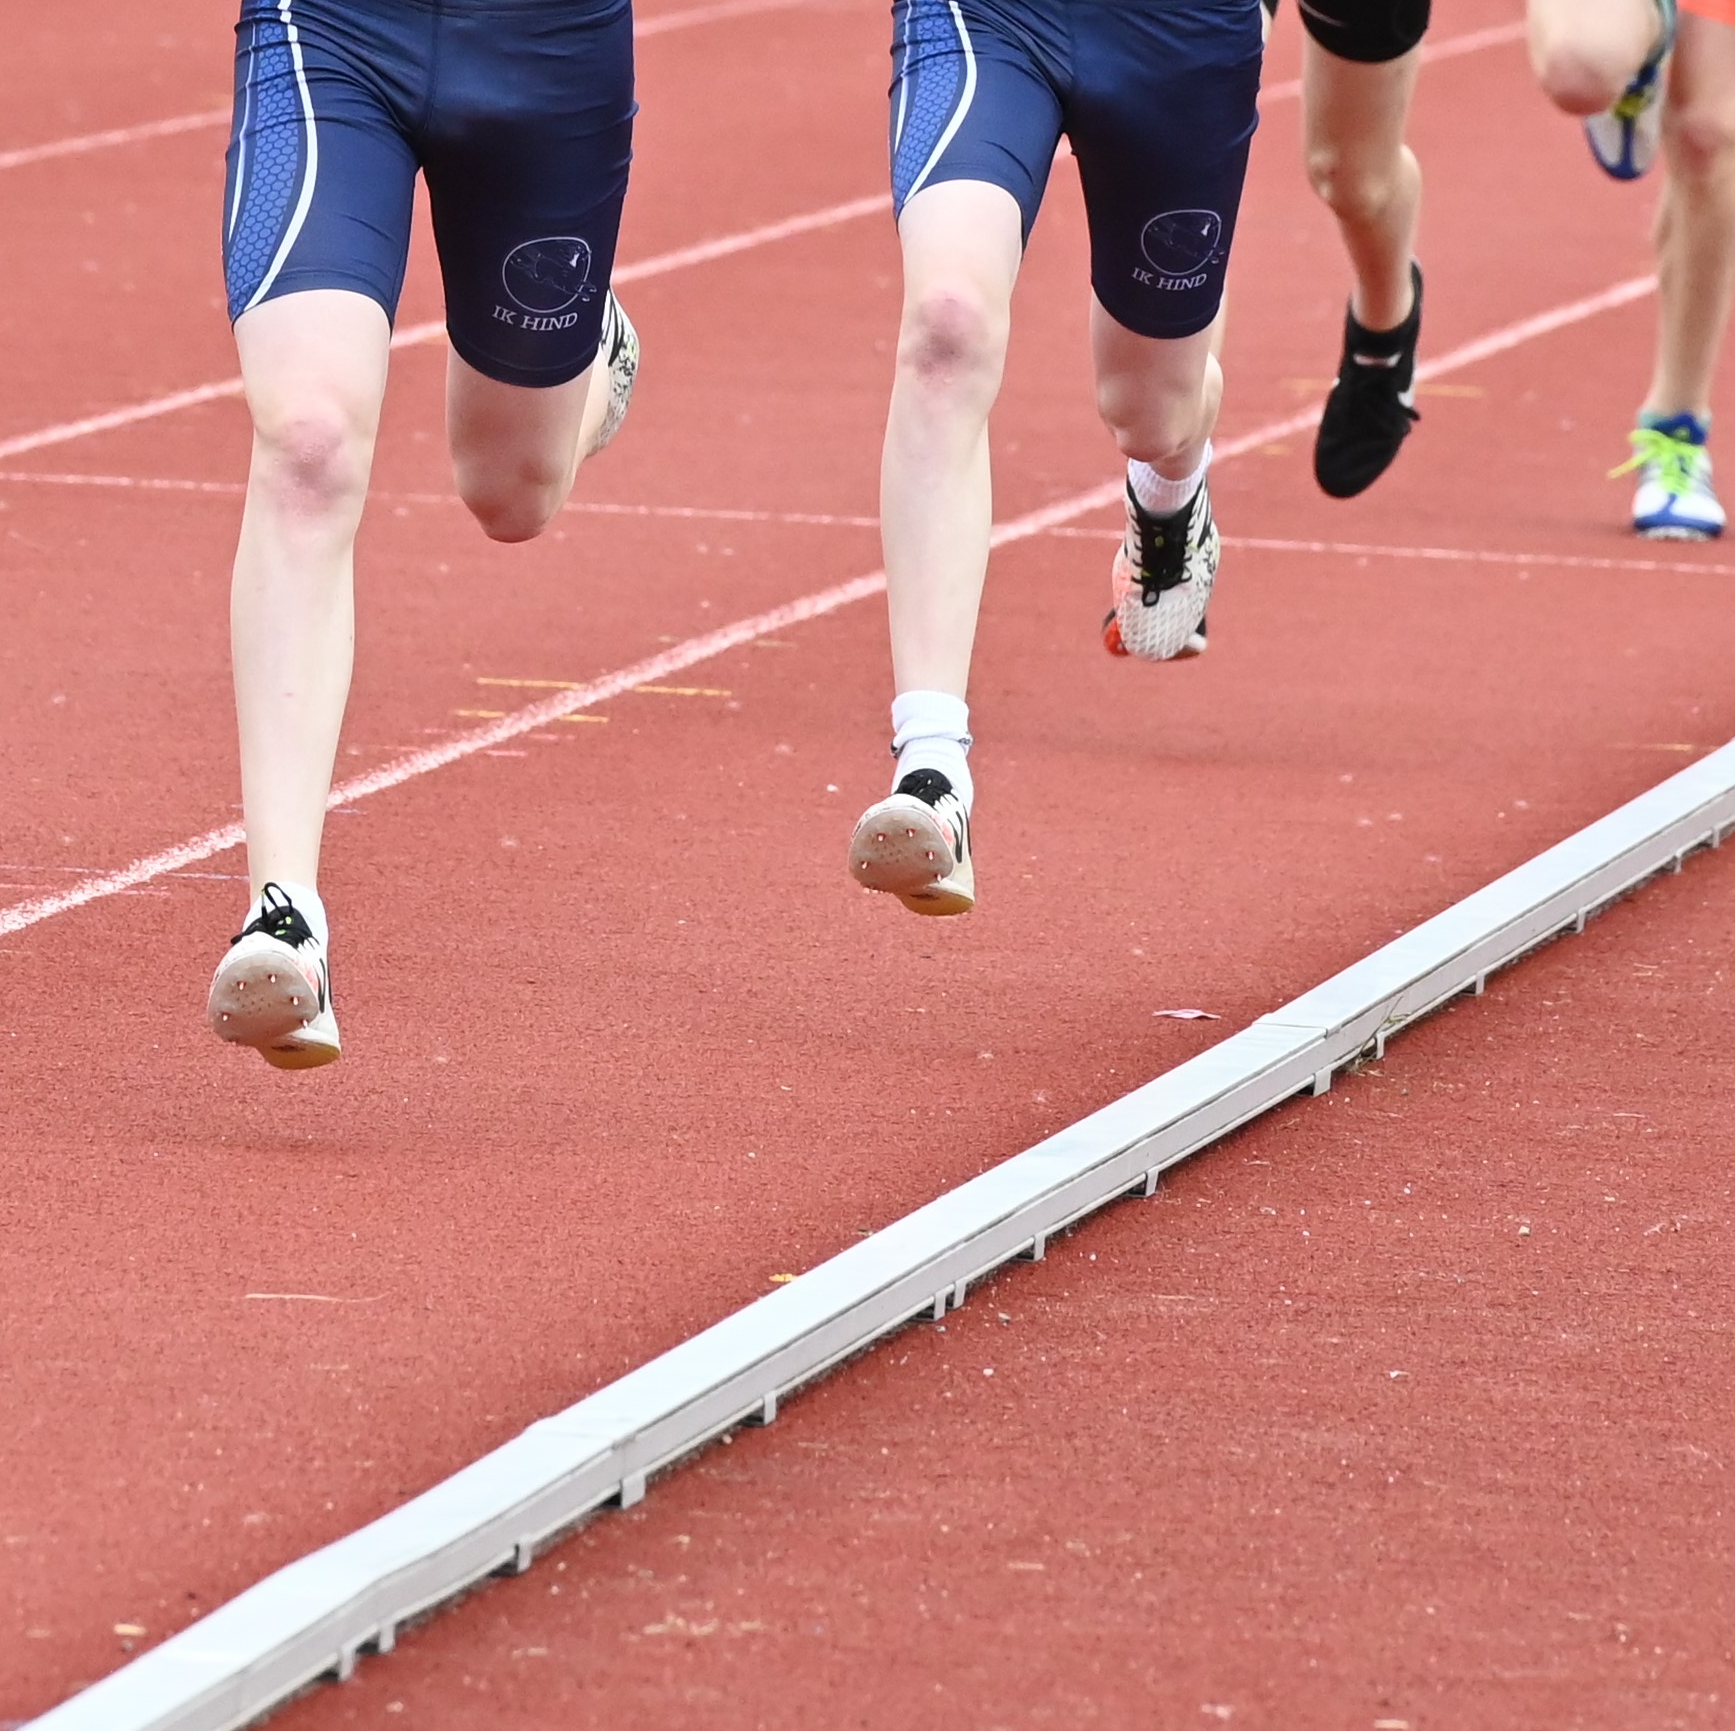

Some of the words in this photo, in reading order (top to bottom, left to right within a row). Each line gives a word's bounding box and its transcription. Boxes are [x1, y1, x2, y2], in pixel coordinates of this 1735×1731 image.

[1132, 267, 1154, 285] IK
[1156, 272, 1208, 291] HIND
[492, 304, 518, 325] IK
[520, 312, 578, 332] HIND
